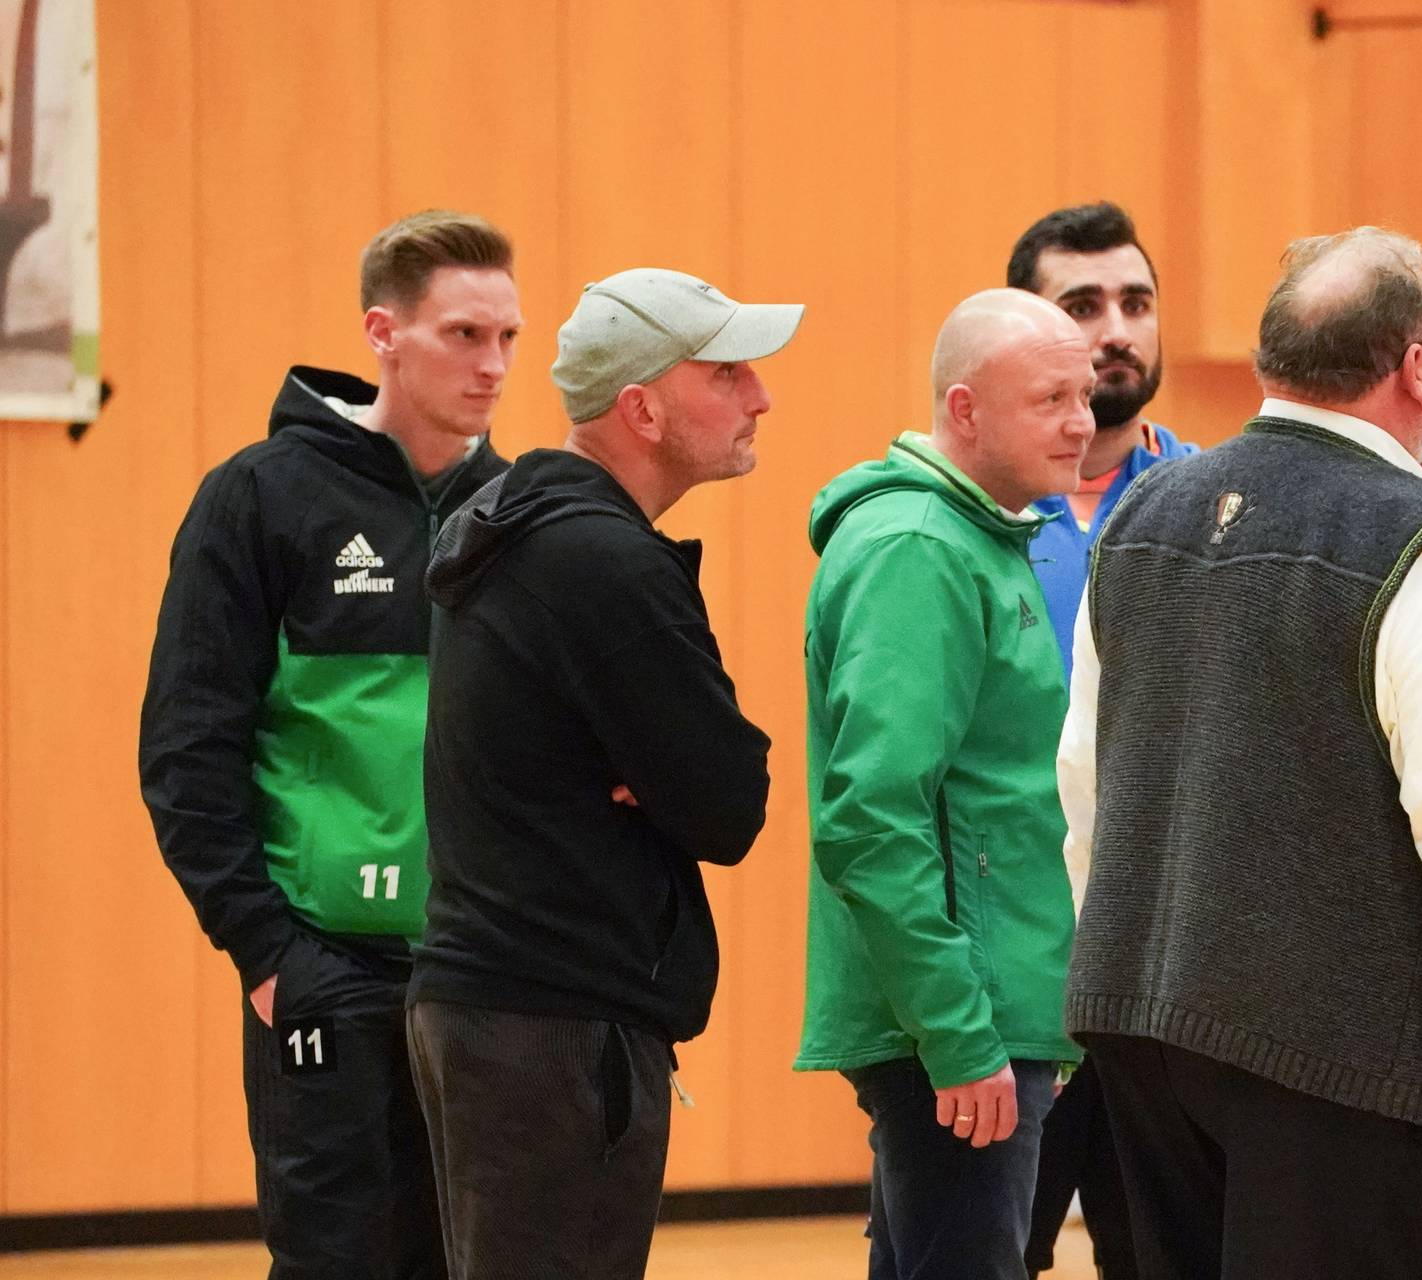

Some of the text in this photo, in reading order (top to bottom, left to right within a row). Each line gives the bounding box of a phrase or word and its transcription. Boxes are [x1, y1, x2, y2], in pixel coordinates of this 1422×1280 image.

[336, 555, 384, 567] adidas
[360, 864, 400, 899] 11
[288, 1028, 322, 1065] 11
